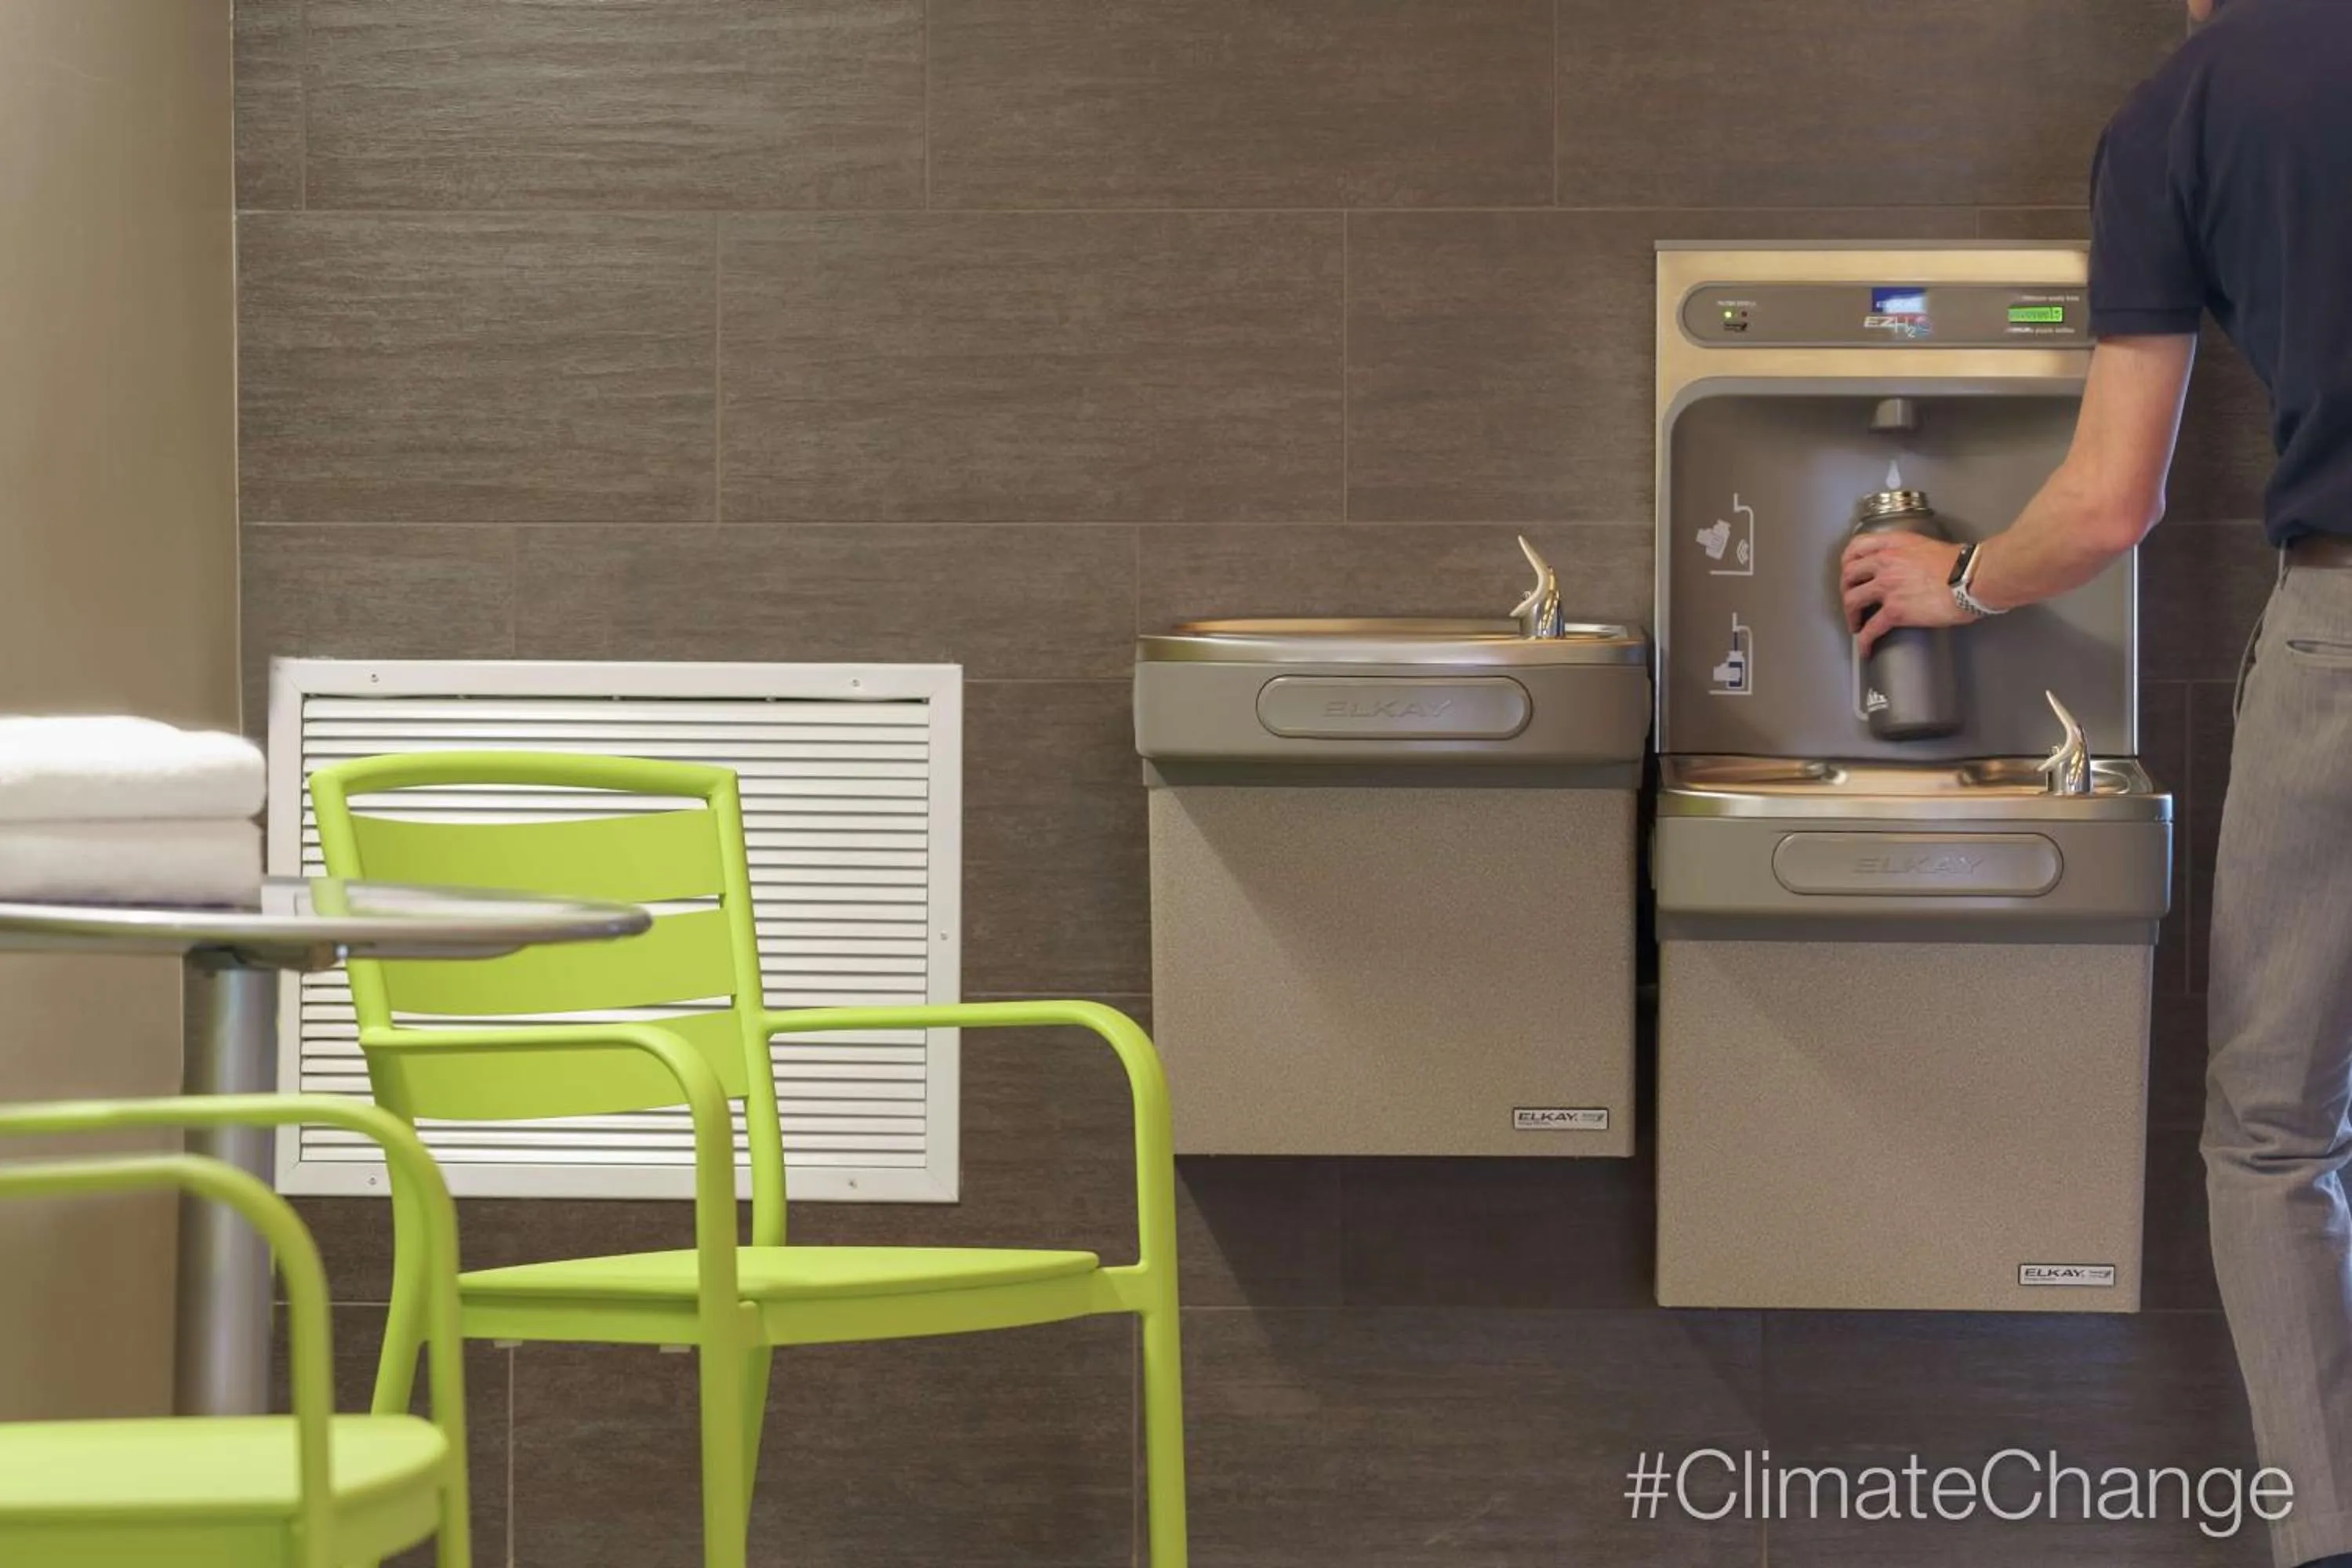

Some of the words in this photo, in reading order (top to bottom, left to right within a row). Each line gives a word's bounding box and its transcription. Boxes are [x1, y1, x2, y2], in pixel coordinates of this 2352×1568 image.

[1321, 699, 1451, 718] ELKAY
[1851, 856, 1984, 875] ELKAY
[2025, 1268, 2085, 1277] ELKAY
